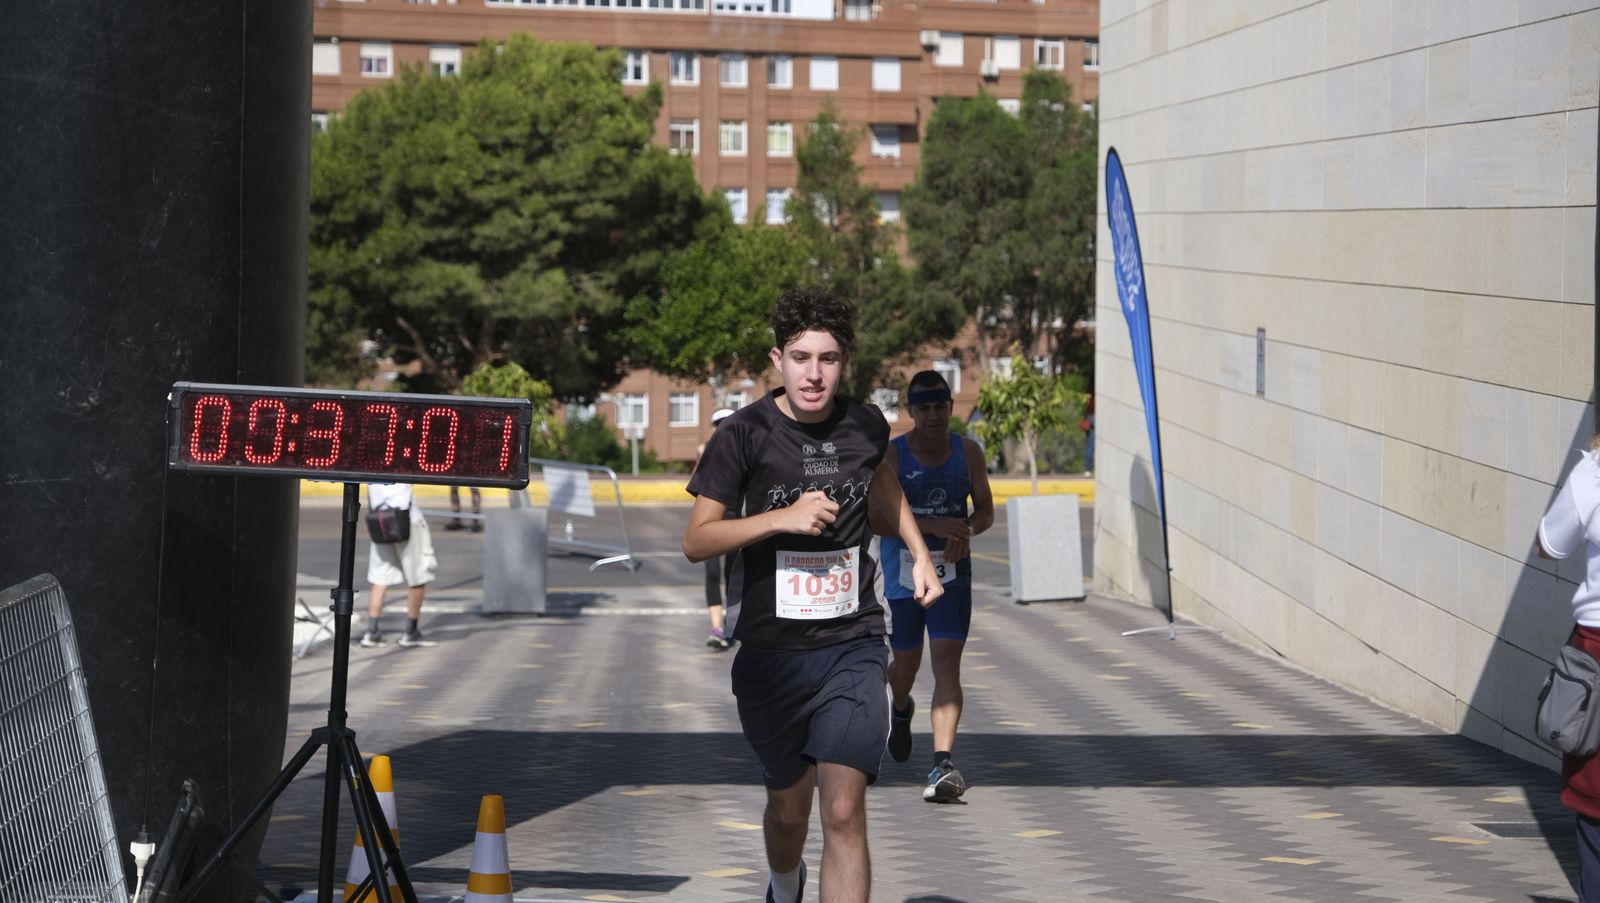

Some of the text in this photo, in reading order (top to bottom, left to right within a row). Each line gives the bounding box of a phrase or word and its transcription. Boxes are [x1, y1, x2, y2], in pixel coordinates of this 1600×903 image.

[803, 461, 829, 469] CIUDAD
[791, 556, 824, 565] CARRERA
[787, 571, 853, 596] 1039
